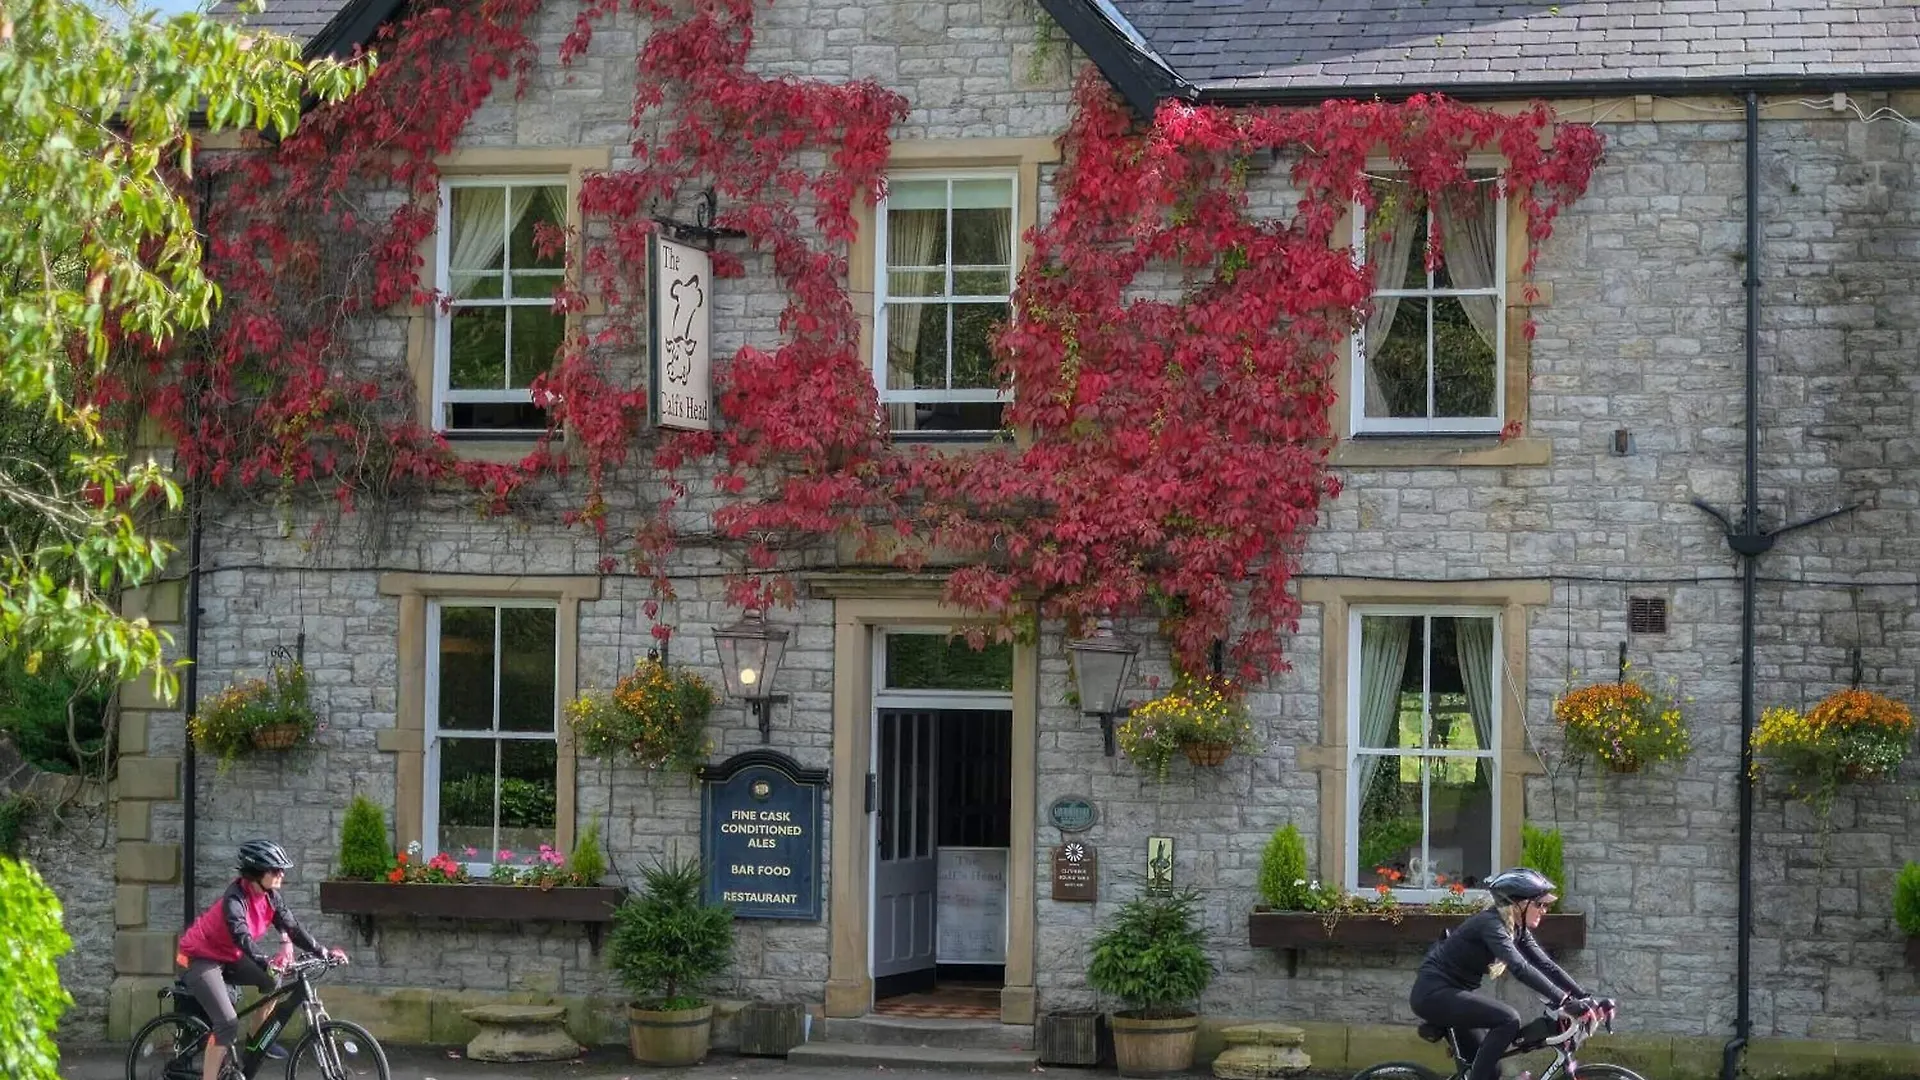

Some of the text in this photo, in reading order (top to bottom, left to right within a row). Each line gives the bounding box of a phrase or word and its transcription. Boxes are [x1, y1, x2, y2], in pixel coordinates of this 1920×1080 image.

[662, 245, 680, 271] The
[685, 396, 708, 421] Head
[731, 810, 790, 821] FINE CASK
[721, 824, 802, 835] CONDITIONED
[748, 838, 776, 848] ALES
[731, 864, 791, 876] BAR FOOD
[723, 891, 797, 904] RESTAURANT
